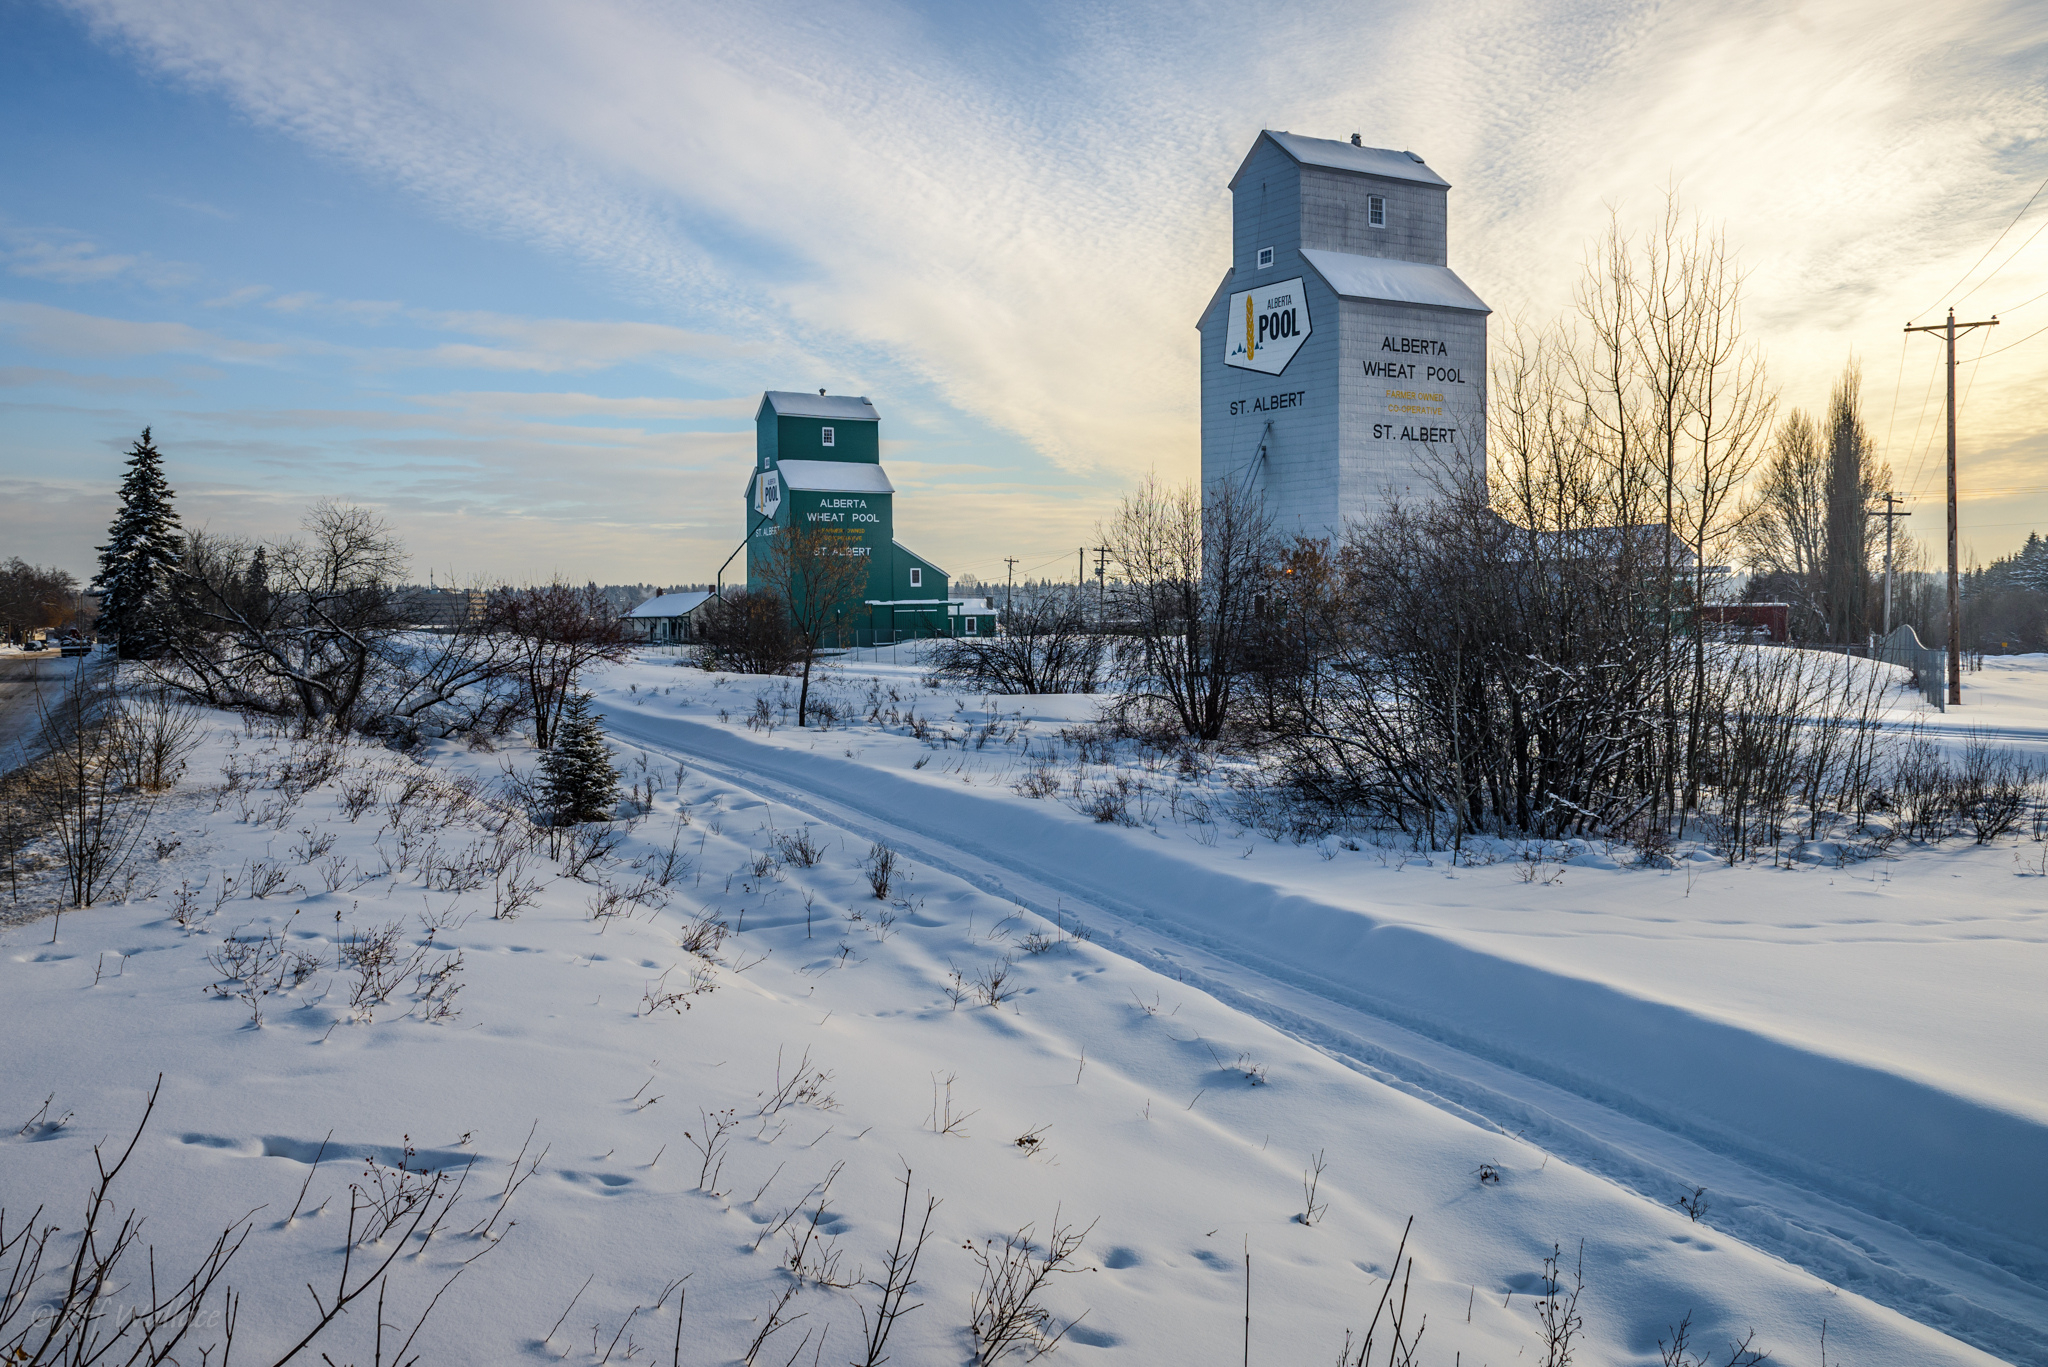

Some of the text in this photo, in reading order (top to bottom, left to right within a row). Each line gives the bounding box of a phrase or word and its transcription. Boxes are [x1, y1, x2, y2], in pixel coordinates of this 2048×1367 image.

[1267, 294, 1292, 310] ALBERTA
[1259, 308, 1301, 343] POOL
[1381, 336, 1448, 357] ALBERTA
[1363, 361, 1466, 383] WHEAT POOL
[1230, 391, 1305, 416] ST. ALBERT
[1386, 389, 1444, 402] FARMER OWNED
[1388, 404, 1443, 416] CO-OPERATIVE
[1373, 424, 1456, 443] ST. ALBERT
[765, 485, 779, 503] POOL
[820, 499, 867, 509] ALBERTA
[807, 512, 880, 523] WHEAT POOL
